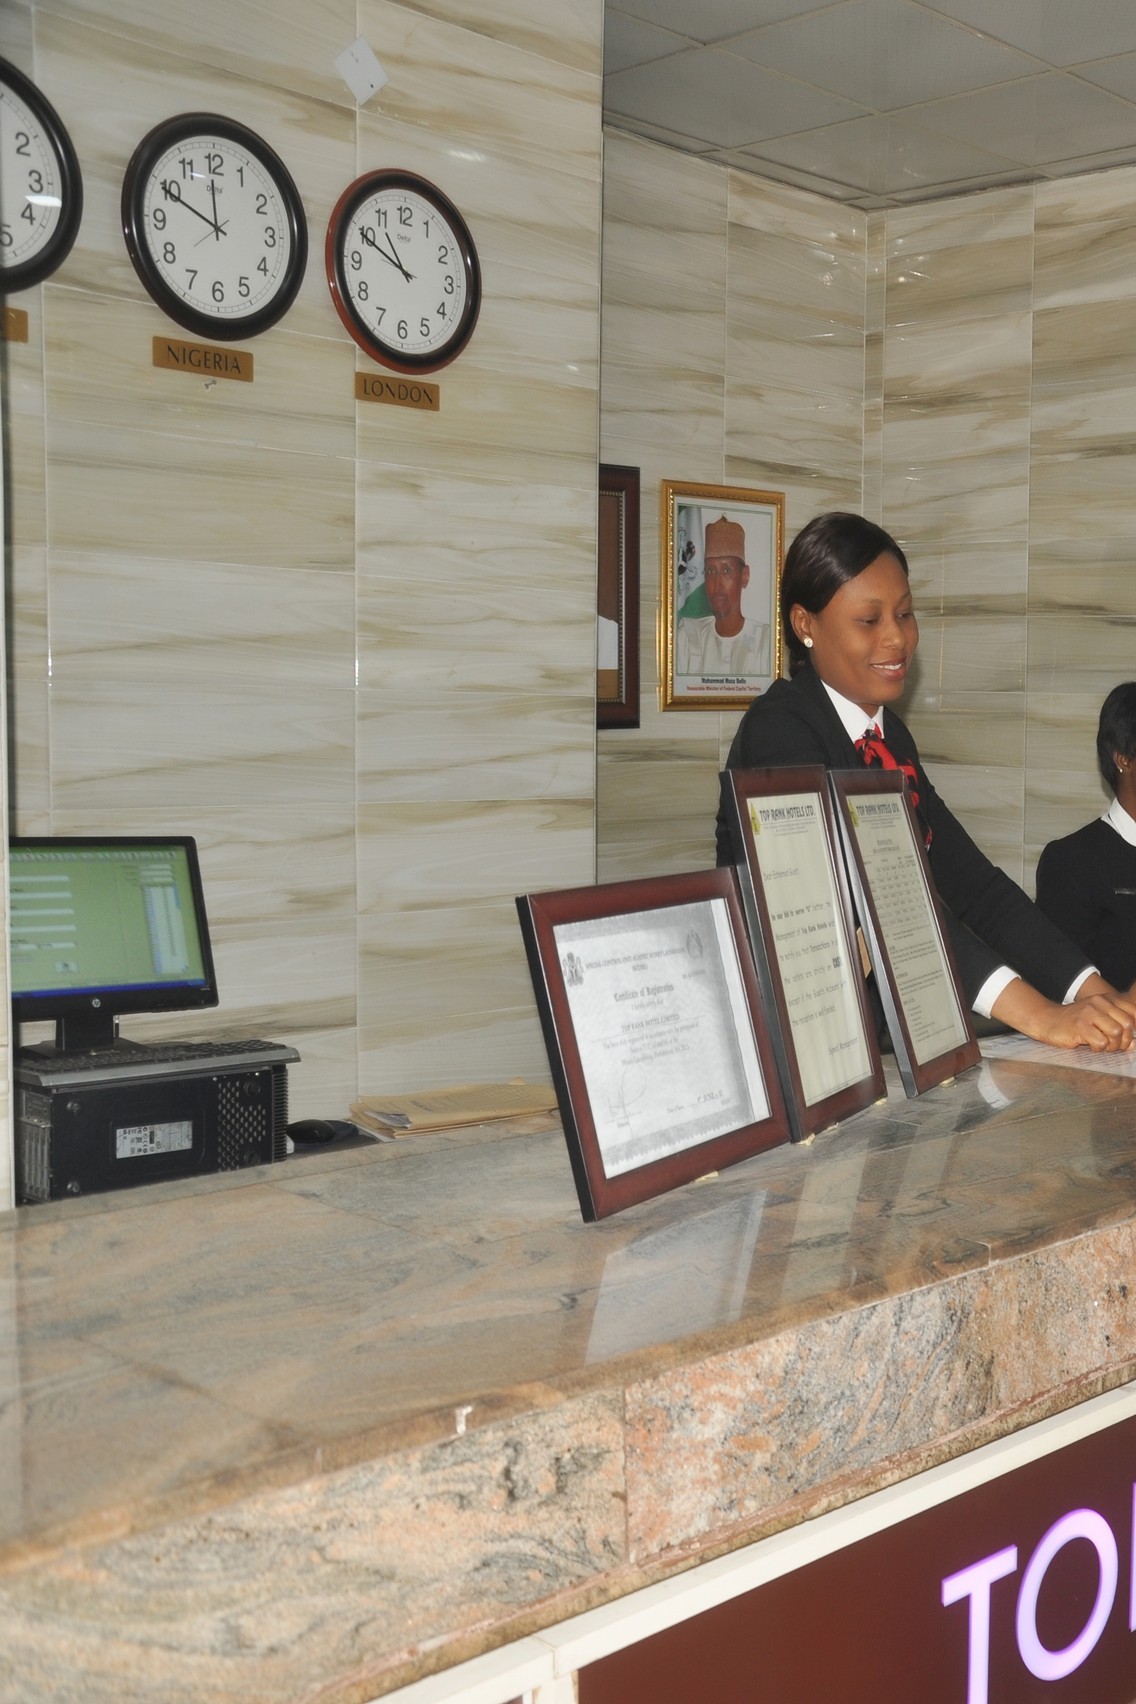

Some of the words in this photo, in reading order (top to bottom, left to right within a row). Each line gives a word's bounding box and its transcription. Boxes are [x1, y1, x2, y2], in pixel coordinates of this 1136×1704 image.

[15, 132, 31, 157] 2
[178, 157, 194, 181] 11
[204, 152, 224, 177] 12
[28, 170, 44, 194] 3
[236, 166, 244, 188] 1
[160, 178, 181, 203] 10
[21, 203, 36, 226] 4
[255, 193, 268, 216] 2
[153, 208, 166, 231] 9
[375, 208, 388, 229] 11
[396, 205, 413, 227] 12
[264, 226, 276, 248] 3
[358, 225, 376, 247] 10
[423, 220, 430, 239] 1
[163, 242, 176, 264] 8
[351, 251, 362, 271] 9
[438, 245, 449, 265] 2
[257, 256, 269, 277] 4
[185, 269, 198, 290] 7
[238, 276, 250, 298] 5
[444, 275, 454, 295] 3
[212, 281, 224, 303] 6
[358, 281, 369, 301] 8
[376, 307, 386, 326] 7
[437, 301, 447, 320] 4
[397, 320, 408, 340] 6
[419, 317, 430, 337] 5
[167, 345, 241, 374] NIGERIA
[363, 379, 433, 404] LONDON
[759, 809, 770, 821] TOP
[771, 808, 786, 820] RANK
[786, 806, 805, 819] HOTELS
[856, 804, 865, 816] TOP
